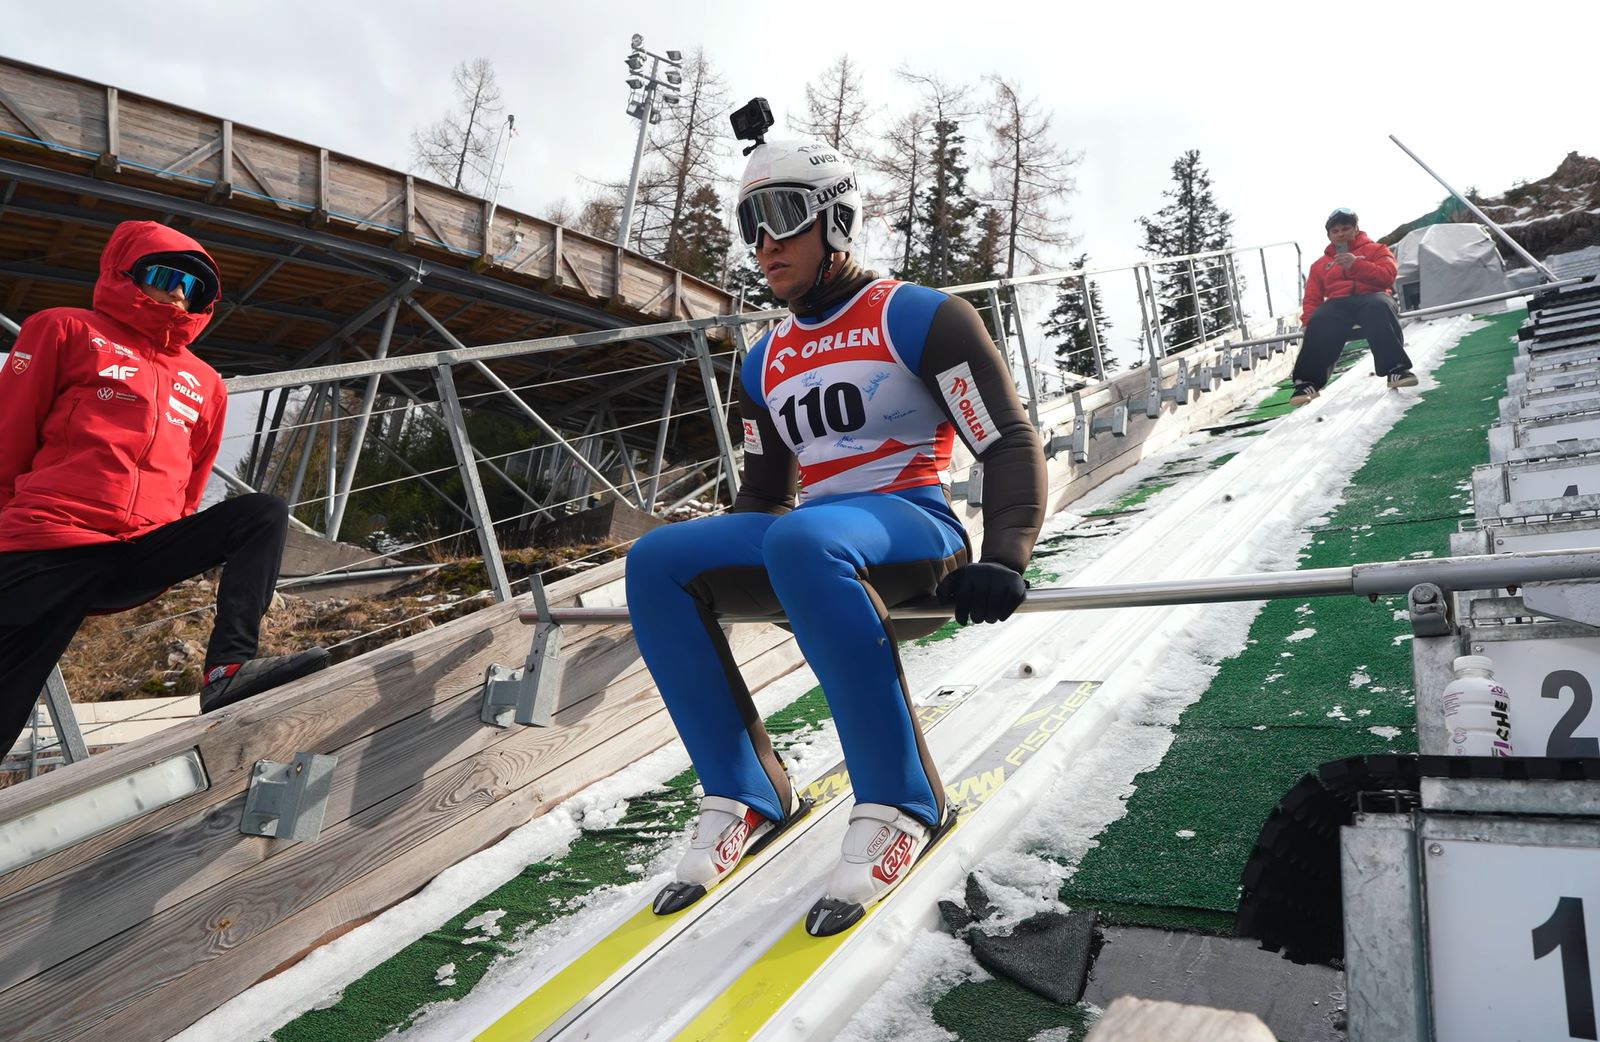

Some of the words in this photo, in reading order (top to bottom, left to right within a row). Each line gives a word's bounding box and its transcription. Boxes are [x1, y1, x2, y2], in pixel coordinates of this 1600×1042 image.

[809, 154, 839, 166] uvex
[816, 177, 854, 205] uvex
[801, 326, 880, 359] ORLEN
[173, 382, 204, 405] ORLEN
[779, 381, 867, 447] 110
[958, 399, 988, 443] ORLEN
[1004, 680, 1094, 766] FISCHER
[1540, 669, 1600, 757] 2
[867, 827, 890, 855] EAGLE
[1531, 896, 1598, 1041] 1
